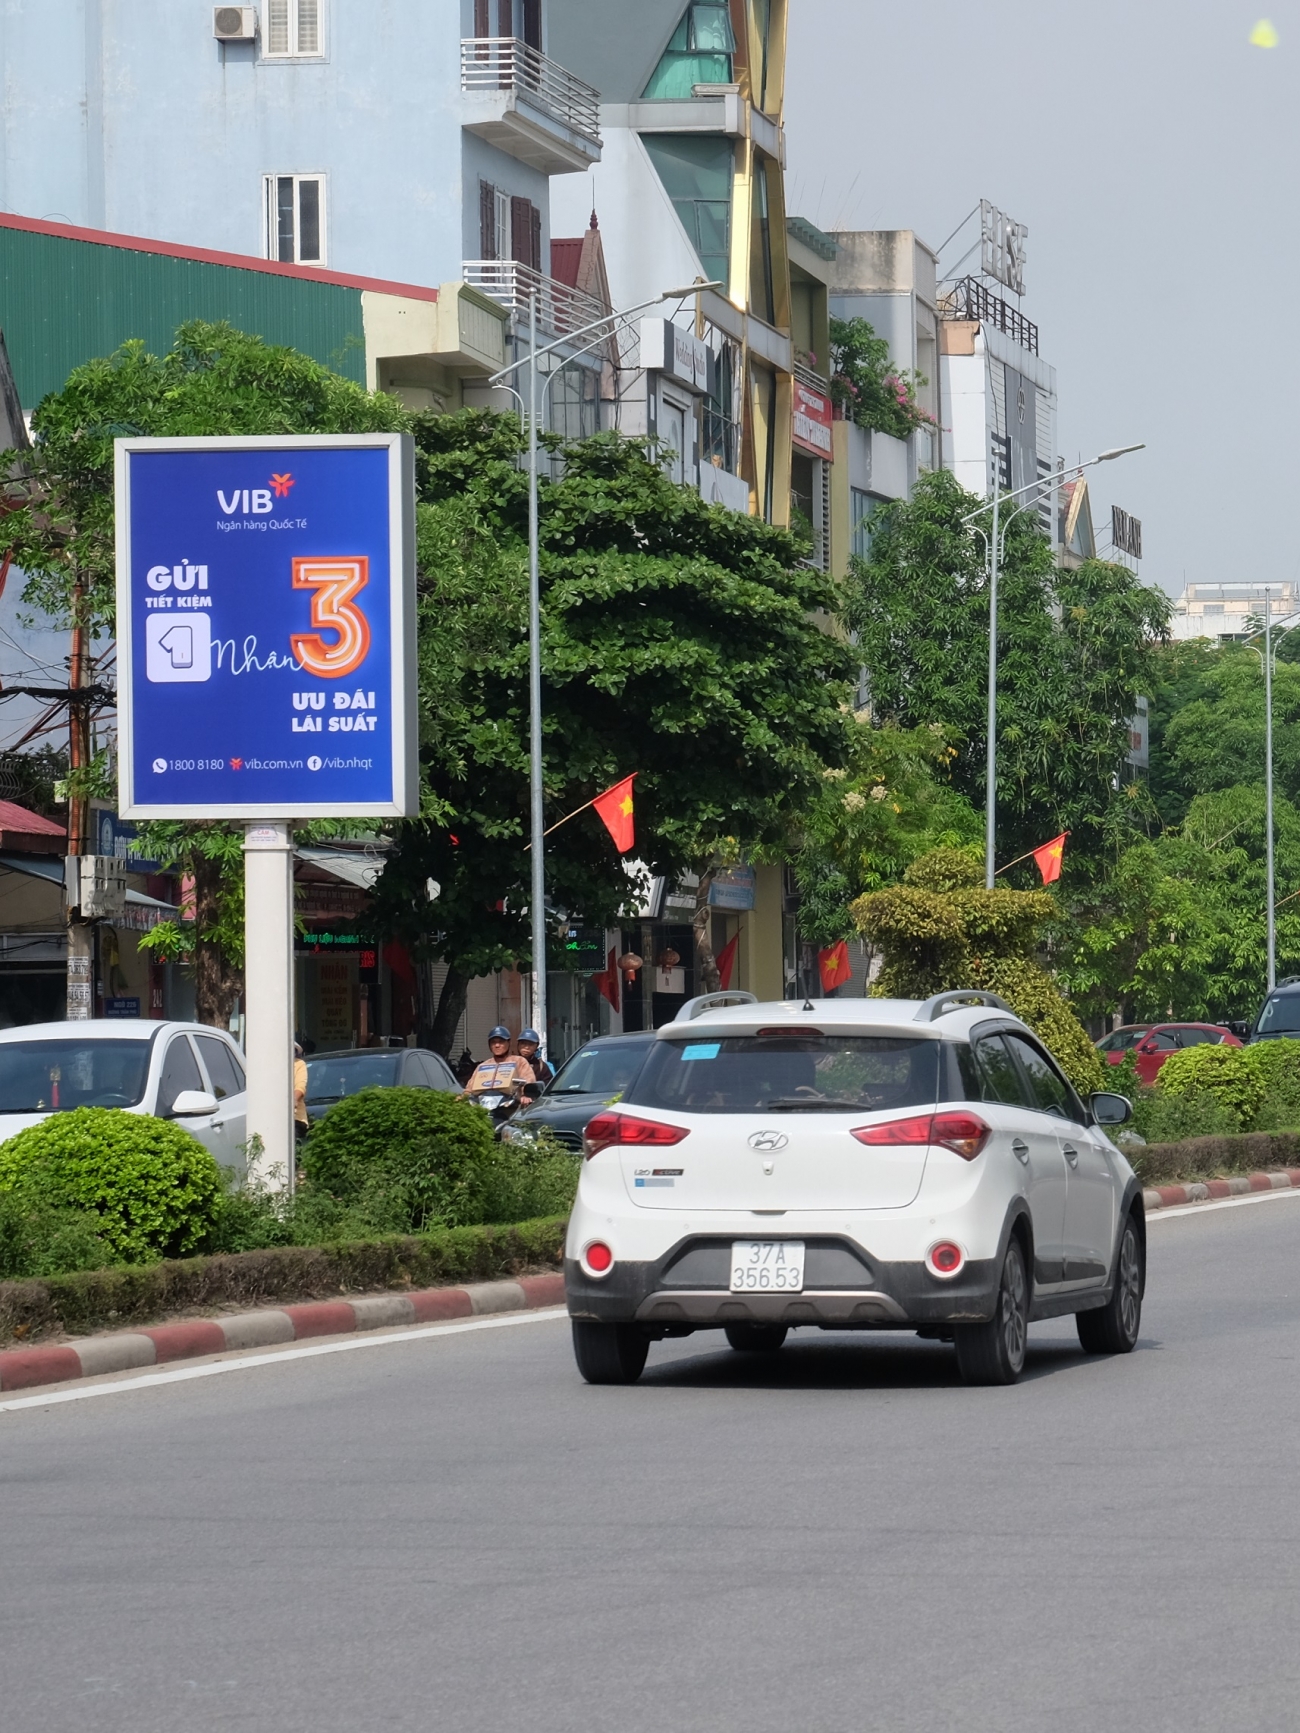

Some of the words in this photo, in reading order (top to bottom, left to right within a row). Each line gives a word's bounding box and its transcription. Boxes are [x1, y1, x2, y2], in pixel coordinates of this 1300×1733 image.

[217, 489, 273, 514] VIB
[217, 521, 241, 532] Ngân
[243, 520, 267, 531] hàng
[269, 518, 294, 529] Quốc
[295, 518, 307, 528] Tế
[147, 558, 208, 591] GỬI
[145, 594, 173, 608] TIẾT
[177, 594, 212, 610] KIỆM
[289, 556, 371, 678] 3
[211, 635, 304, 676] Nhận
[292, 692, 325, 710] ƯU
[333, 688, 376, 710] ĐÃI
[292, 714, 322, 732] LÃI
[328, 714, 377, 732] SUẤT
[170, 759, 194, 770] 1800
[197, 759, 224, 770] 8180
[245, 758, 303, 770] vib.com.vn
[749, 1243, 785, 1264] 37A
[733, 1267, 800, 1288] 356.53
